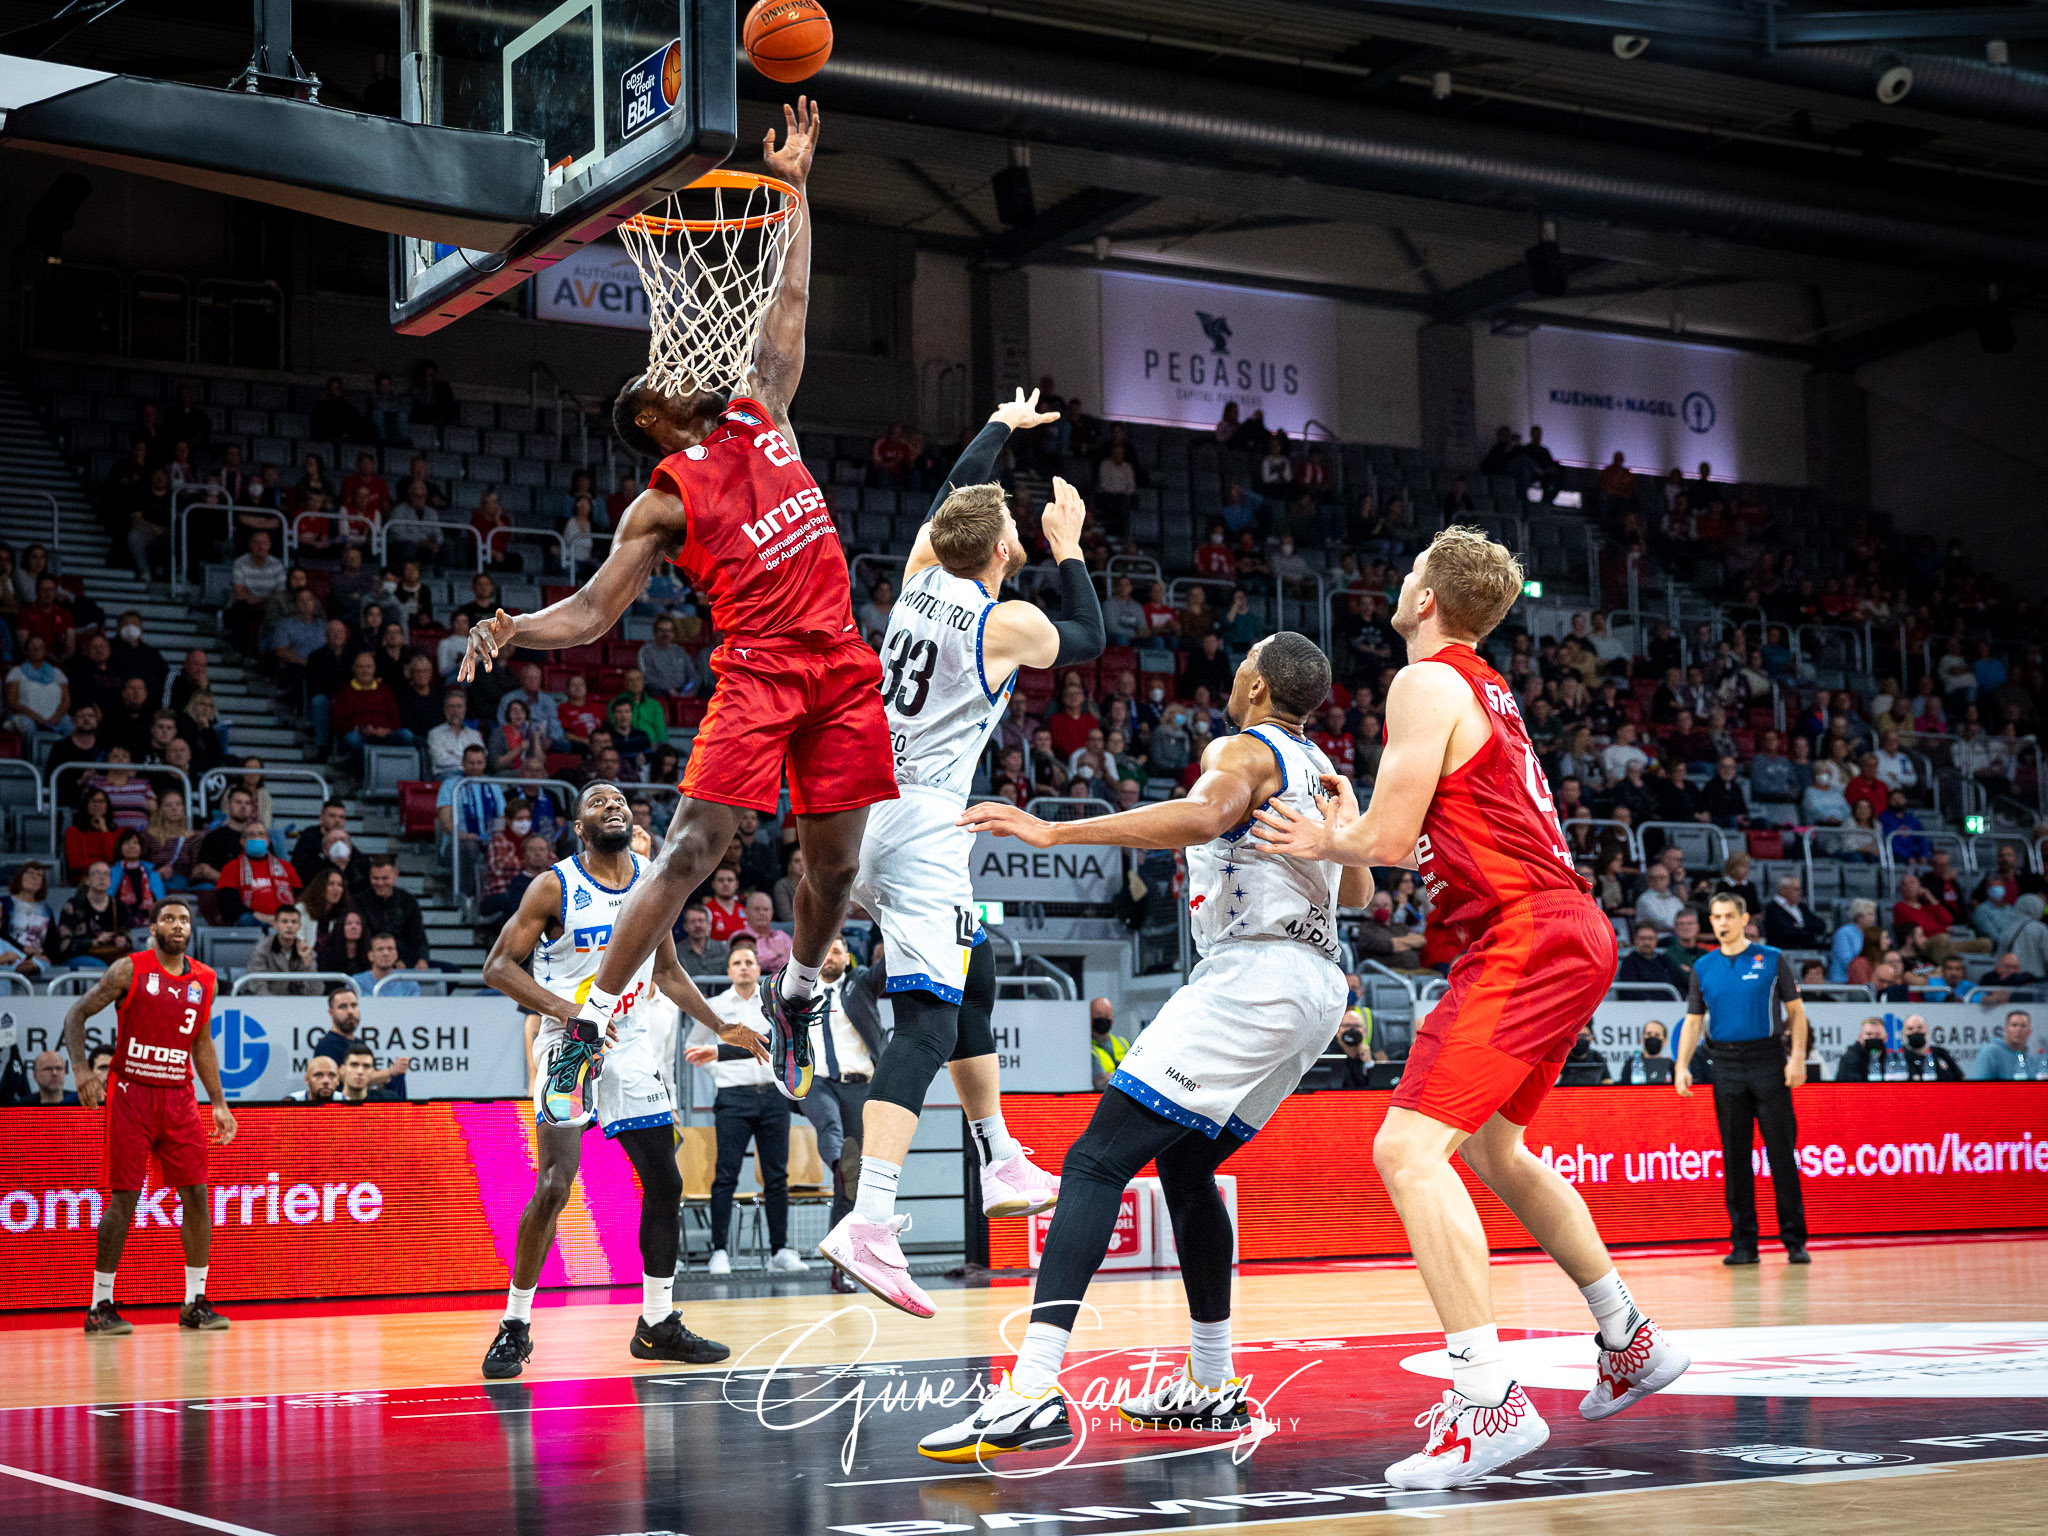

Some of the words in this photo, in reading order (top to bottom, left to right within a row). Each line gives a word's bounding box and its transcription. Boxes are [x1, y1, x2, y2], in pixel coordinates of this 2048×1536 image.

[627, 91, 656, 130] BBL
[1145, 349, 1298, 394] PEGASUS
[765, 557, 781, 571] der
[881, 628, 938, 717] 33
[979, 852, 1104, 879] ARENA
[609, 899, 623, 907] HAK
[179, 1008, 198, 1035] 3
[408, 1057, 469, 1072] GMBH
[1165, 1066, 1197, 1092] HAKRO
[1625, 1143, 1724, 1182] unter:
